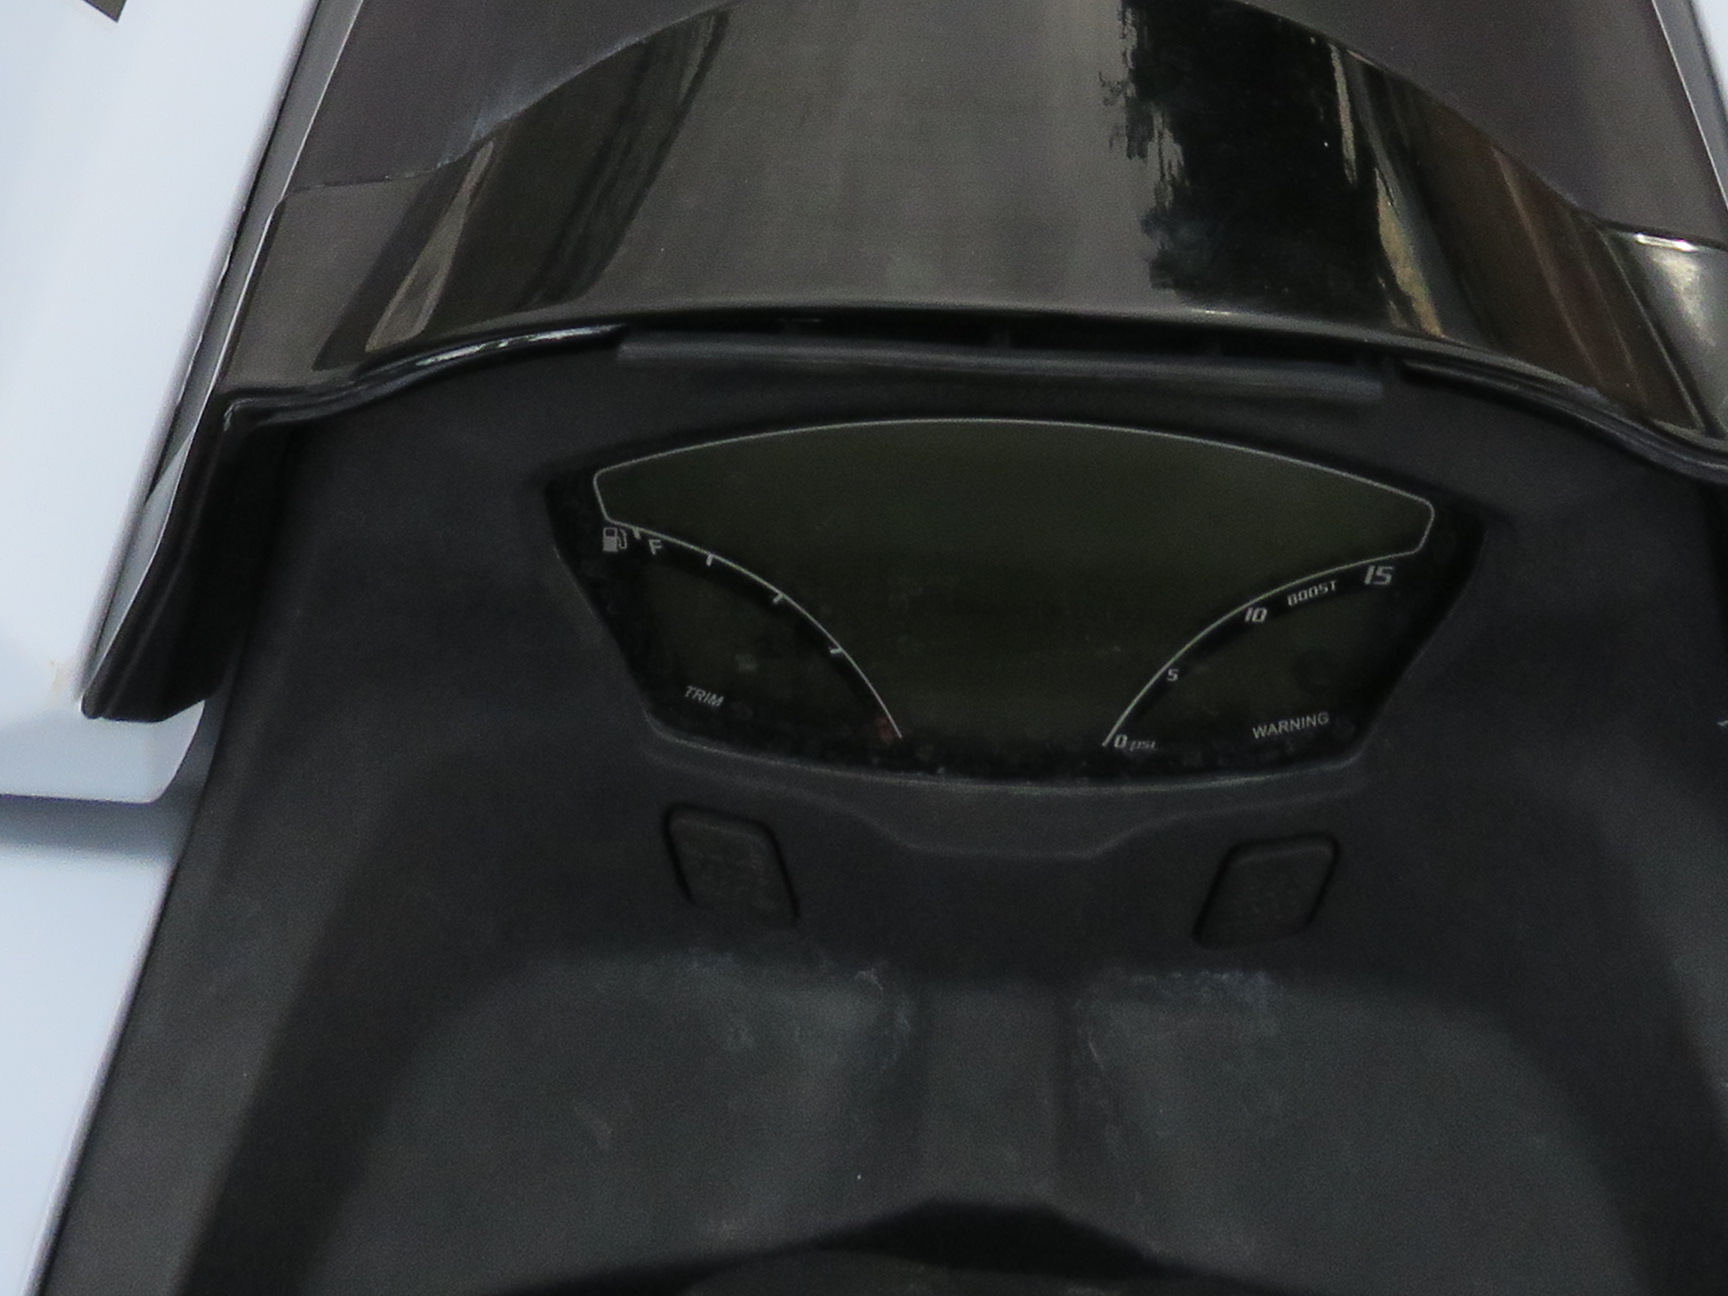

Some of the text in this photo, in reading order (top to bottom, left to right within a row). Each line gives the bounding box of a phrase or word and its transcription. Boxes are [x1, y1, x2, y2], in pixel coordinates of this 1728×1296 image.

[648, 539, 664, 556] F
[1363, 564, 1395, 588] 15
[1287, 579, 1338, 608] BOOST
[1243, 606, 1268, 624] 10
[1166, 668, 1180, 683] 5
[684, 685, 725, 709] TRIM
[1252, 711, 1330, 739] WARNING
